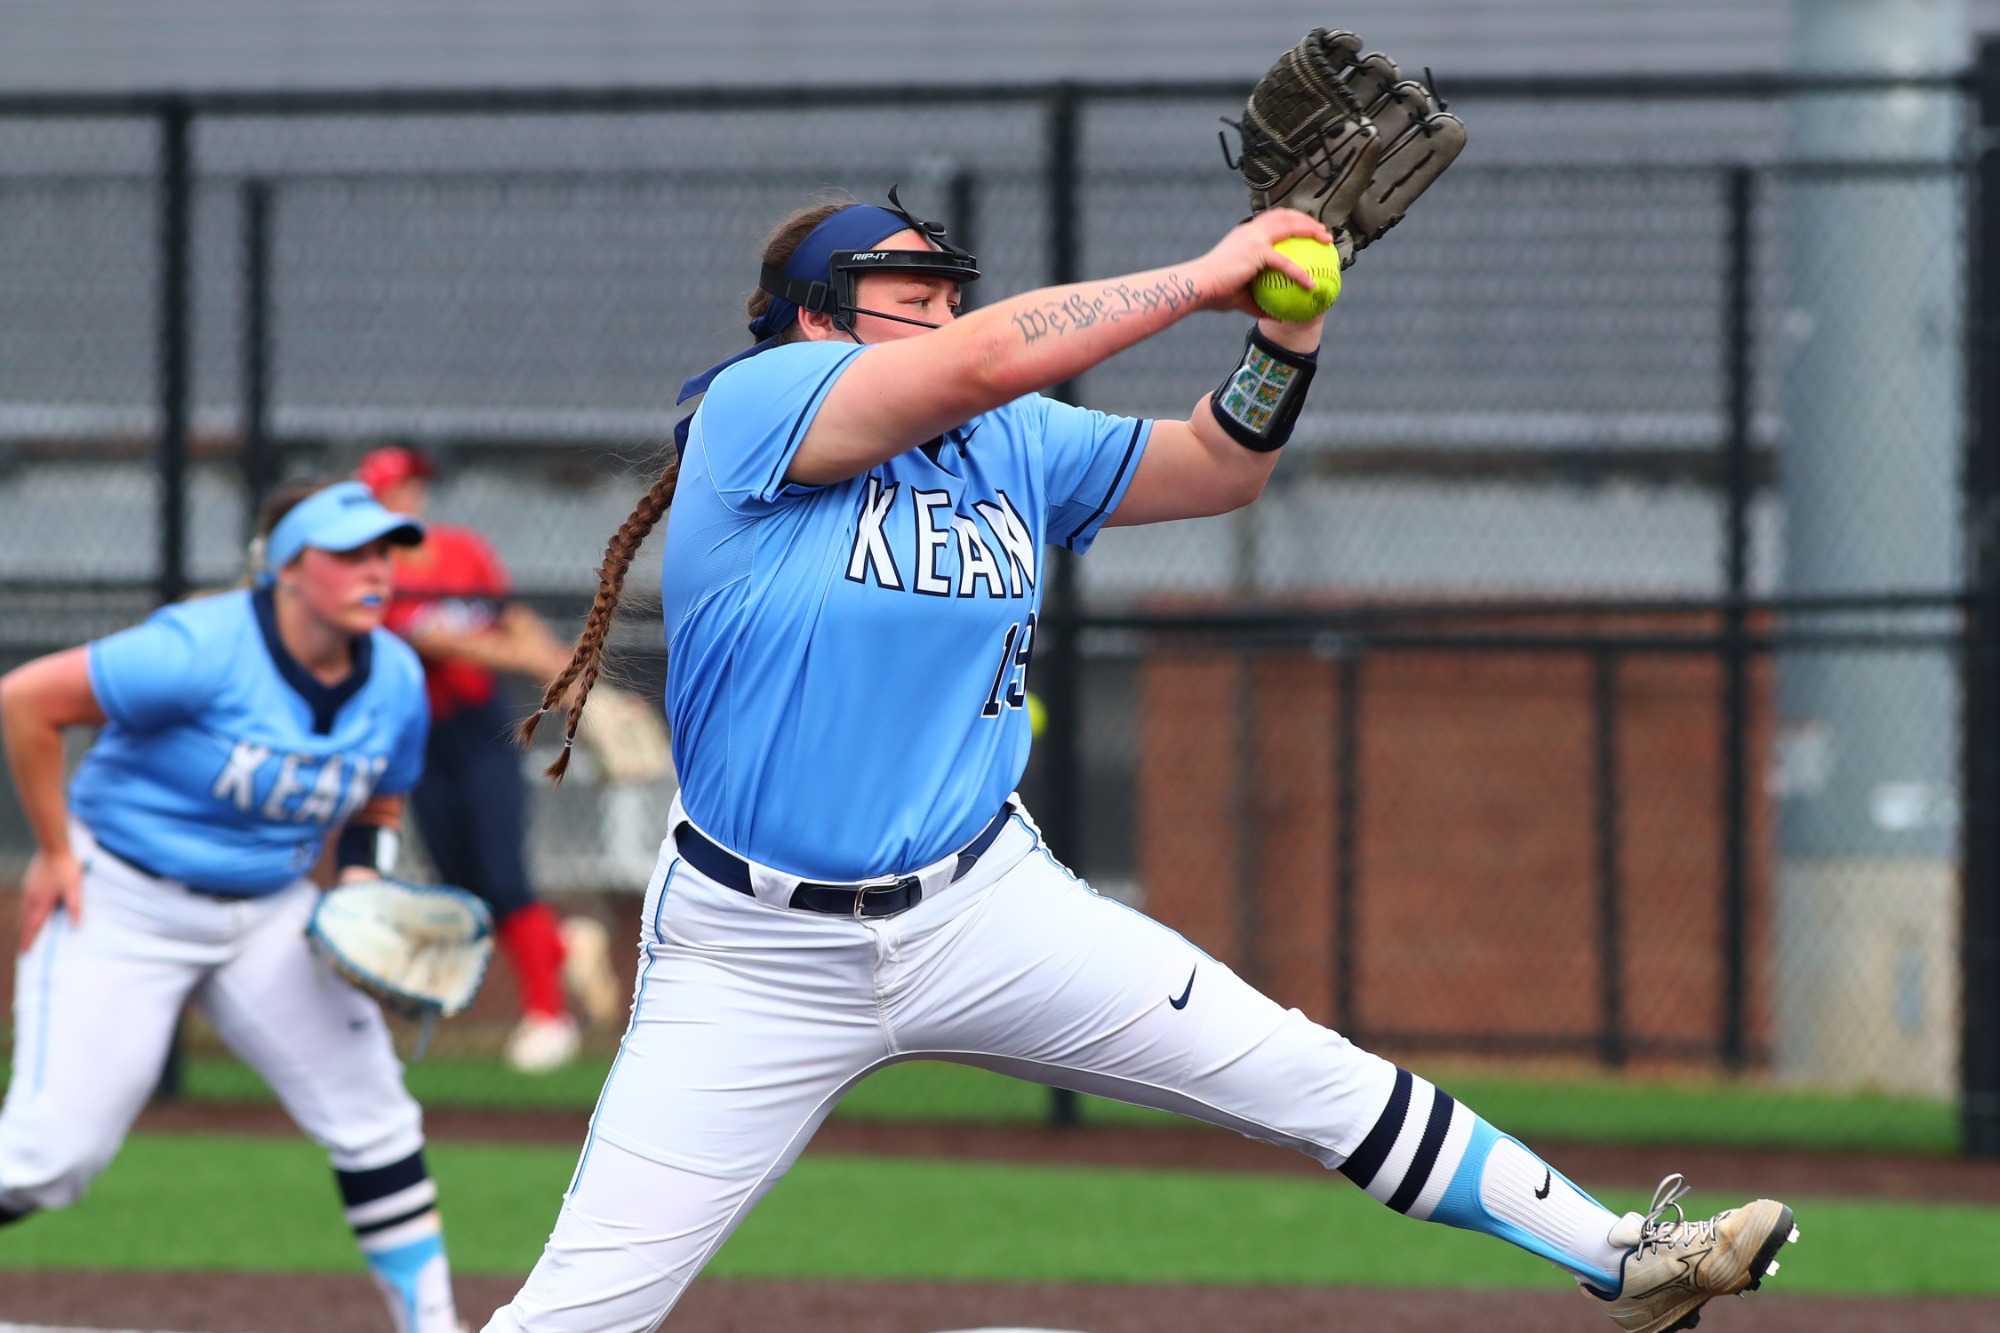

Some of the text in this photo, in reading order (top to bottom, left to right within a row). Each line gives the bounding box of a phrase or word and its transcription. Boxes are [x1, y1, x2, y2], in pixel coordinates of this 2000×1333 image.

[851, 252, 890, 261] RIP-IT
[1011, 306, 1068, 346] We
[1103, 273, 1204, 323] People
[844, 476, 1036, 599] KEAN
[980, 609, 1038, 719] 19
[212, 740, 389, 825] KEAN
